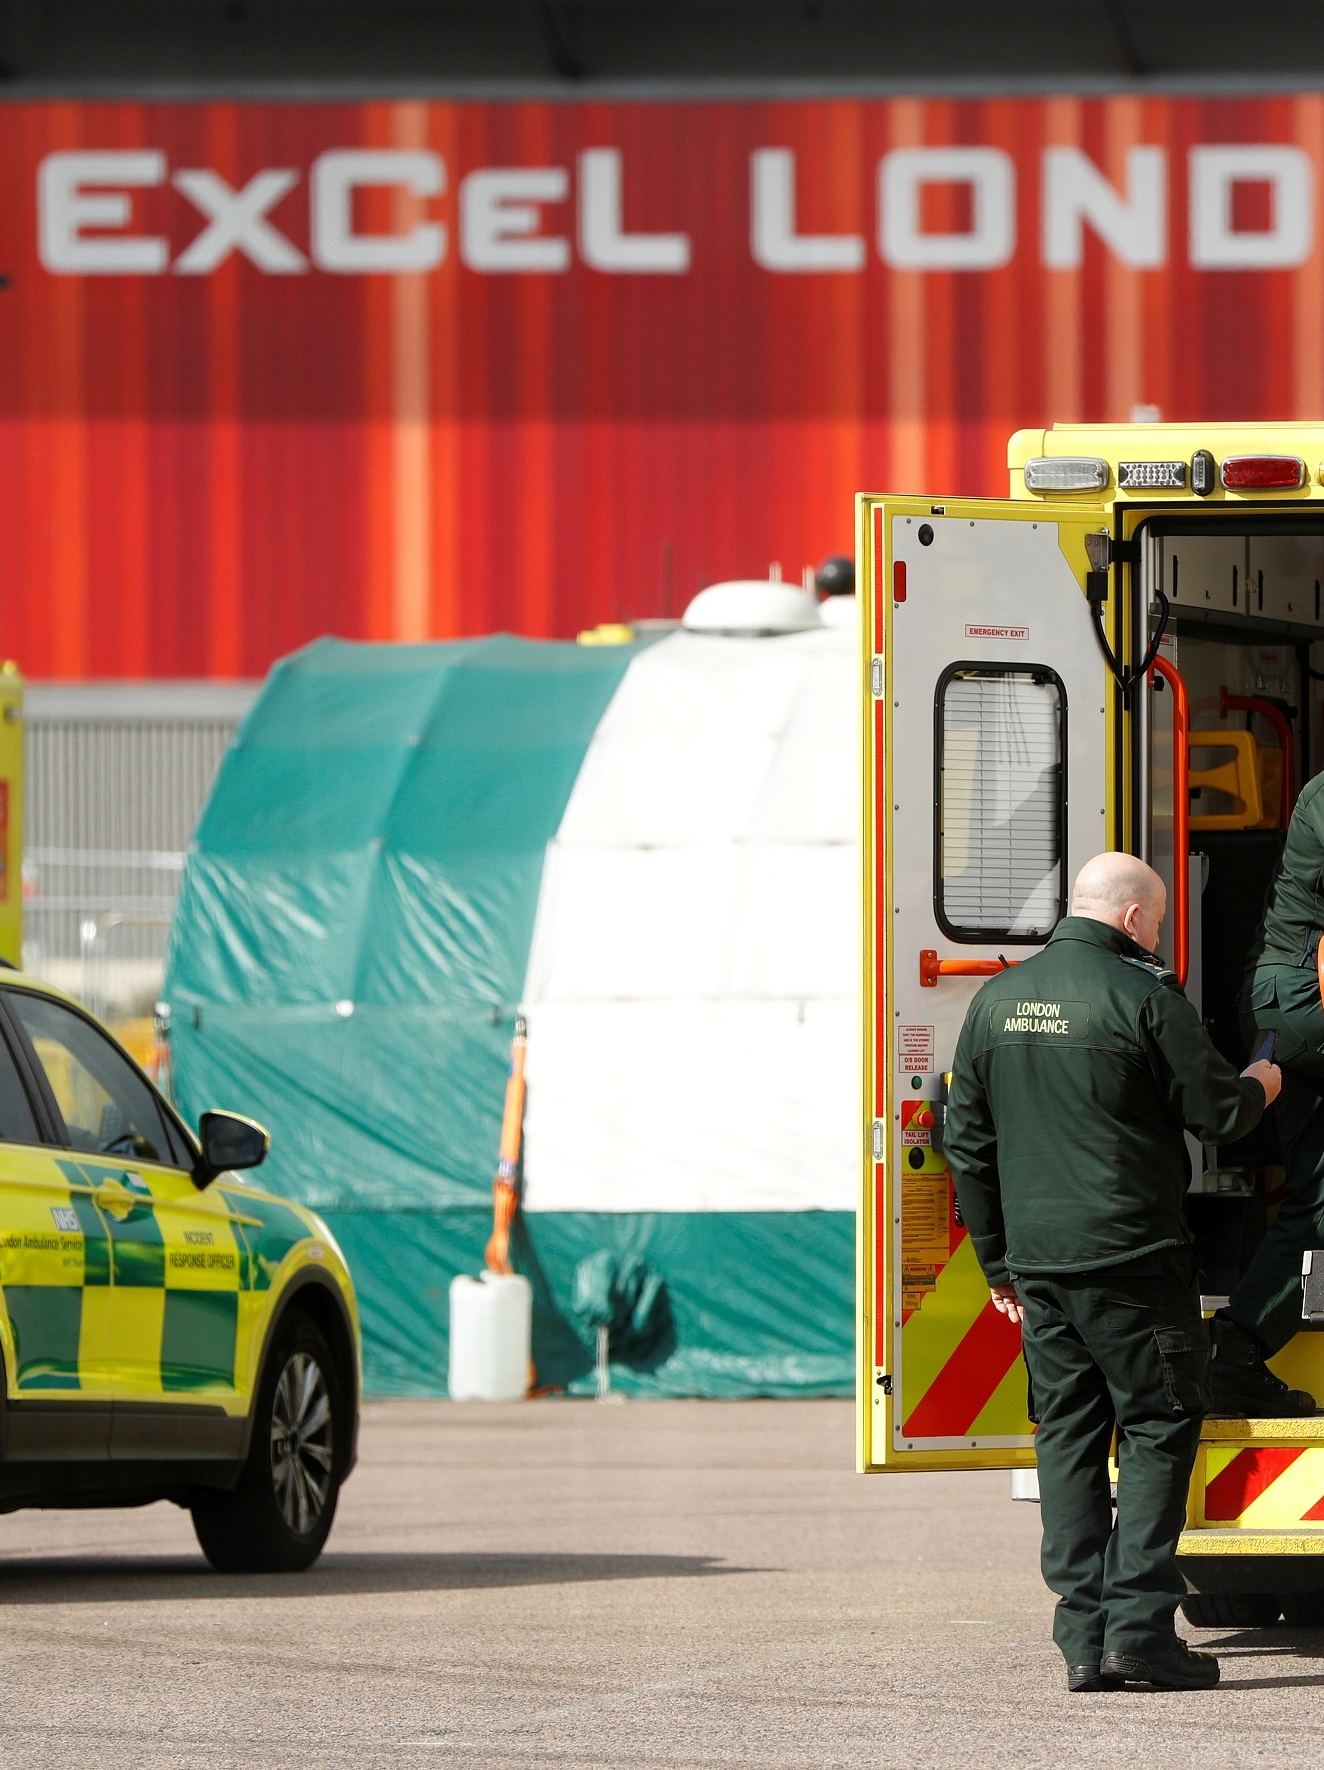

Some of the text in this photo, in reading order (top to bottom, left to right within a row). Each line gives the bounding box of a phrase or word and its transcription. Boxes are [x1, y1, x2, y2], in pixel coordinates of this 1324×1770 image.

[969, 627, 1025, 638] EMERGENCY EXIT
[1016, 1002, 1060, 1018] LONDON
[24, 1234, 59, 1250] Ambulance
[60, 1236, 83, 1252] Service
[169, 1252, 236, 1270] RESPONSE OFFICER
